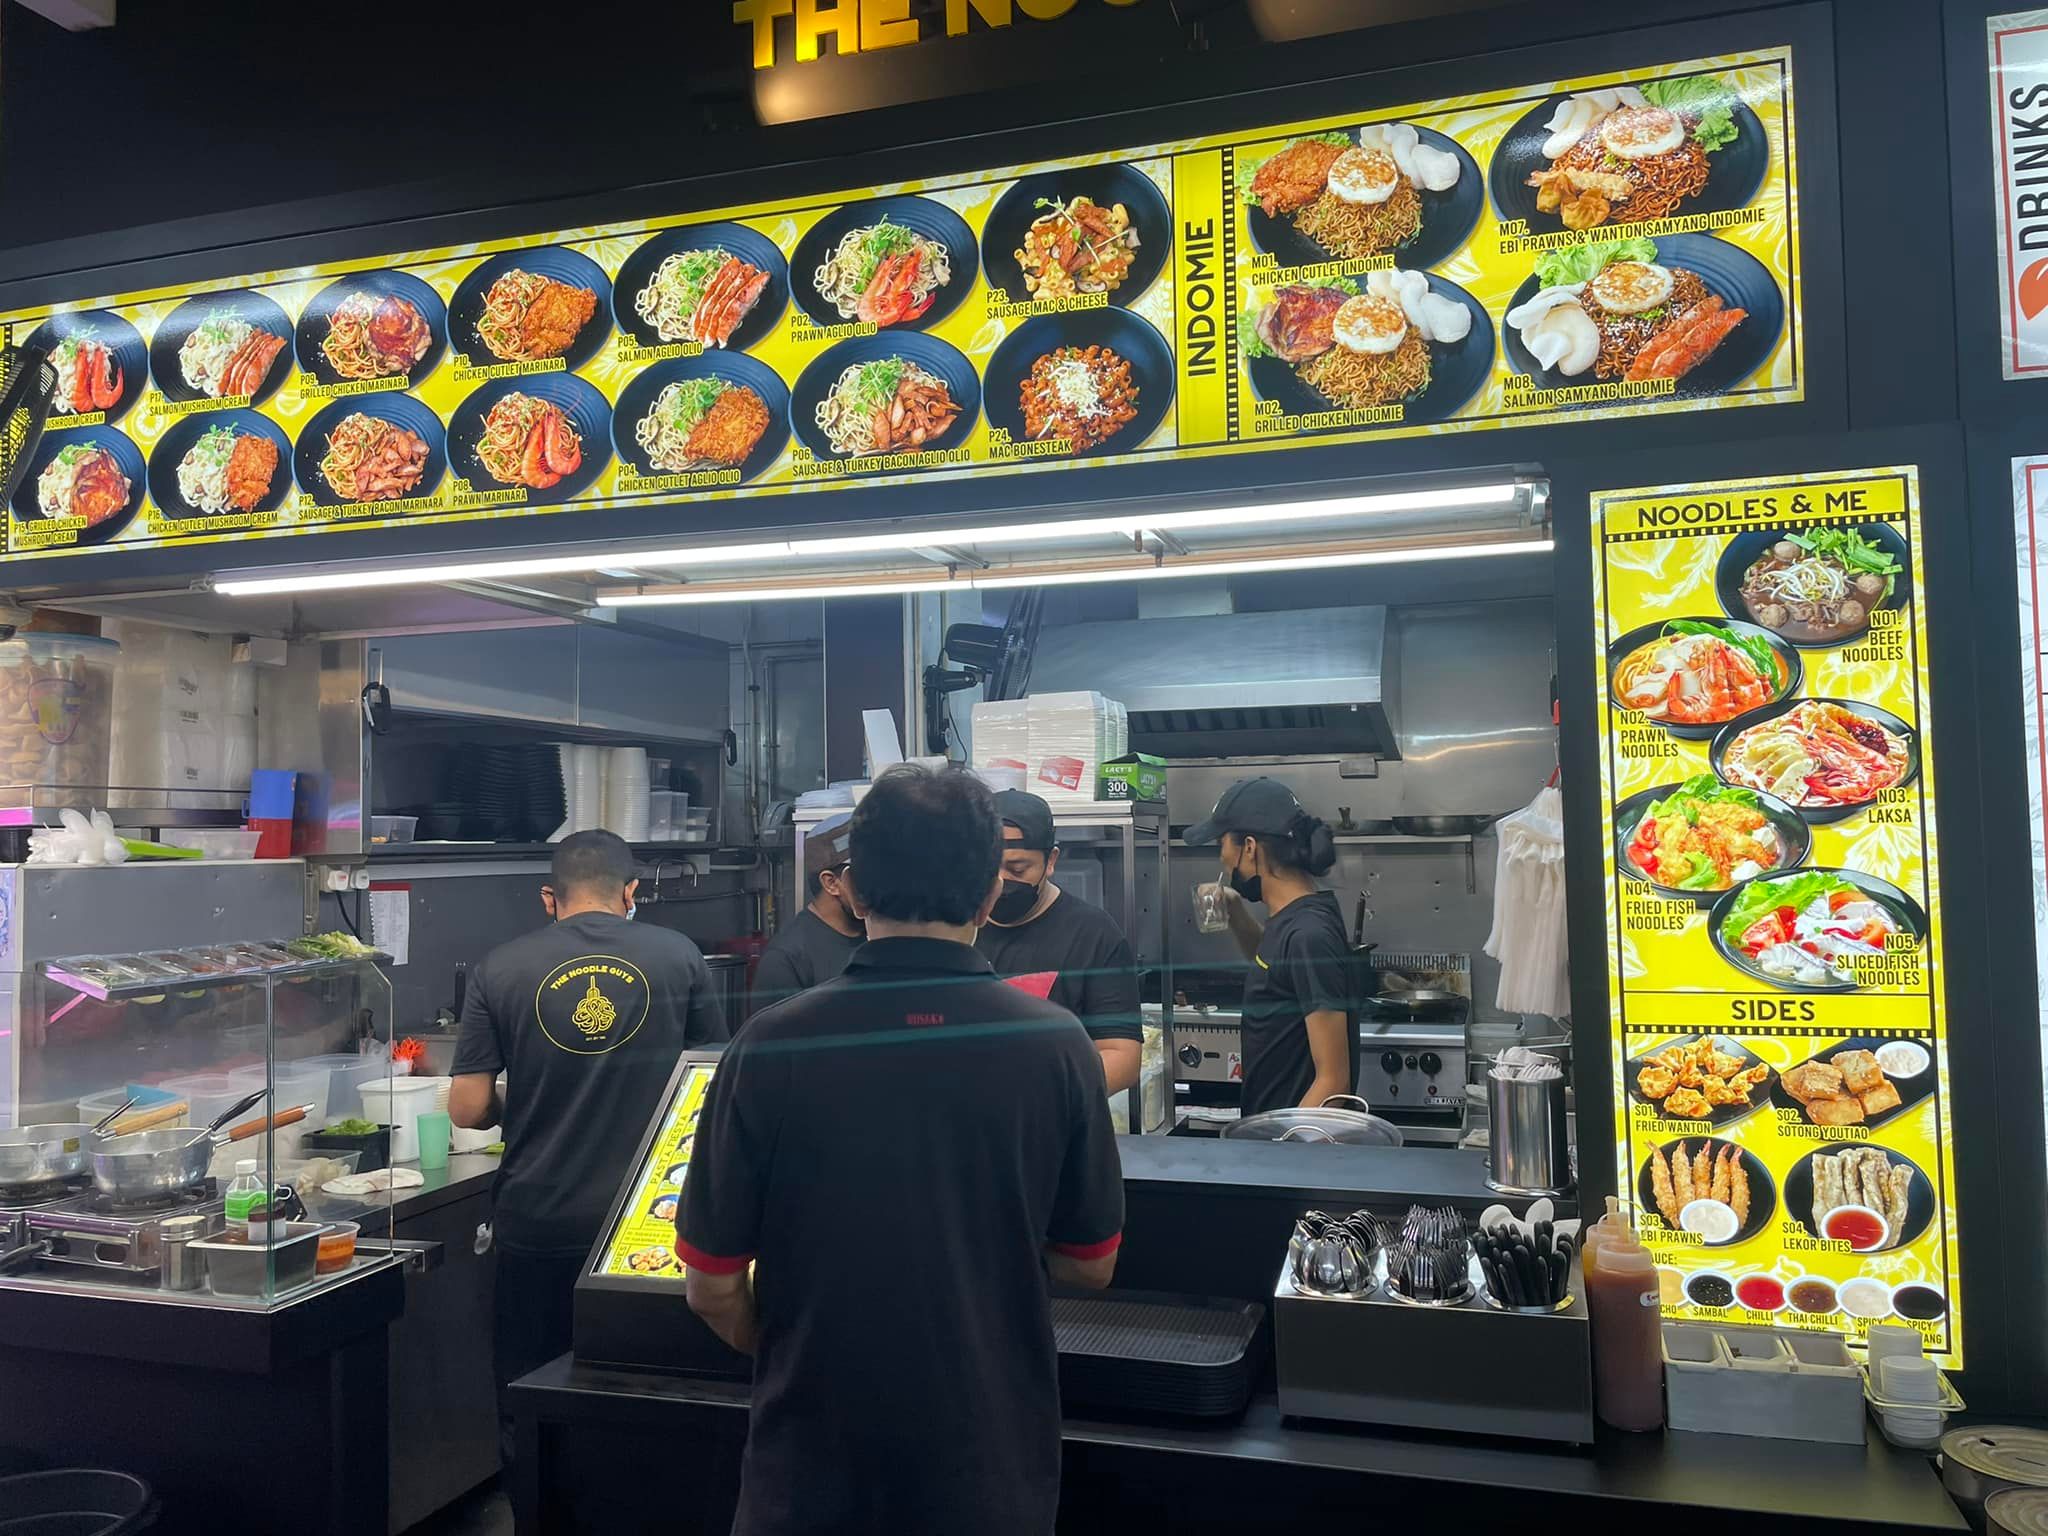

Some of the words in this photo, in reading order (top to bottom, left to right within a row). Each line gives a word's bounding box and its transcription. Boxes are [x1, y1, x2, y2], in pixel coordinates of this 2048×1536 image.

[733, 0, 919, 69] THE
[1500, 240, 1519, 254] EBI
[1523, 234, 1573, 252] PRAWNS
[1577, 232, 1586, 245] &
[1590, 226, 1642, 243] WANTON
[1646, 217, 1707, 236] SAMYANG
[1710, 210, 1765, 230] INDOMIE
[1251, 271, 1299, 286] CHICKEN
[1302, 265, 1343, 280] CUTLET
[1345, 258, 1394, 275] INDOMIE
[987, 291, 1009, 303] P23.
[1185, 218, 1217, 377] INDOMIE
[987, 304, 1030, 319] SAUSAGE
[1033, 300, 1055, 313] MAC
[1058, 299, 1066, 310] &
[1069, 294, 1107, 309] CHEESE
[791, 329, 823, 343] PRAWN
[826, 325, 853, 338] AGLIO
[855, 322, 876, 334] OLIO
[618, 349, 653, 362] SALMON
[656, 346, 680, 358] AGLIO
[683, 343, 703, 354] OLIO
[454, 369, 488, 381] CHICKEN
[490, 364, 521, 377] CUTLET
[522, 359, 565, 373] MARINARA
[300, 387, 331, 399] GRILLED
[333, 382, 367, 395] CHICKEN
[368, 378, 408, 392] MARINARA
[1504, 392, 1553, 409] SALMON
[1557, 386, 1617, 404] SAMYANG
[1621, 379, 1673, 397] INDOMIE
[149, 405, 178, 416] SALMON
[181, 400, 222, 412] MUSHROOM
[224, 397, 249, 407] CREAM
[46, 416, 79, 429] USHROOM
[80, 413, 104, 425] CREAM
[1255, 418, 1299, 433] GRILLED
[1302, 413, 1351, 429] CHICKEN
[1354, 407, 1403, 423] INDOMIE
[989, 431, 1011, 442] P24.
[989, 446, 1011, 458] MAC
[1013, 440, 1072, 456] BONESTEAK
[792, 462, 833, 476] SAUSAGE
[836, 461, 843, 472] &
[847, 458, 882, 472] TURKEY
[884, 455, 916, 468] BACON
[918, 452, 946, 465] AGLIO
[949, 449, 970, 461] OLIO
[618, 479, 655, 492] CHICKEN
[658, 476, 689, 488] CUTLET
[692, 473, 717, 485] AGLIO
[720, 471, 740, 482] OLIO
[453, 492, 483, 505] PRAWN
[484, 490, 527, 502] MARINARA
[298, 507, 332, 520] SAUSAGE
[343, 504, 372, 516] TURKEY
[375, 501, 400, 513] BACON
[402, 497, 444, 510] MARINARA
[1638, 498, 1777, 528] NOODLES
[1791, 494, 1813, 514] &
[1825, 490, 1867, 512] ME
[30, 520, 55, 530] GRILLED
[57, 518, 86, 528] CHICKEN
[147, 523, 178, 534] CHICKEN
[180, 520, 206, 531] CUTLET
[208, 516, 249, 528] MUSHROOM
[252, 513, 278, 524] CREAM
[14, 534, 52, 546] MUSHROOM
[53, 532, 76, 542] CREAM
[1870, 630, 1902, 645] BEEF
[1842, 647, 1904, 663] NOODLES
[1621, 729, 1665, 744] PRAWN
[1621, 743, 1679, 758] NOODLES
[1107, 782, 1128, 792] 300
[1869, 809, 1912, 824] LAKSA
[1626, 900, 1662, 915] FRIED
[1667, 900, 1695, 915] FISH
[1627, 916, 1684, 931] NOODLES
[1837, 954, 1885, 969] SLICED
[1889, 955, 1919, 969] FISH
[550, 974, 569, 990] THE
[568, 965, 608, 978] NOODLE
[609, 968, 635, 984] GUYS
[1858, 970, 1920, 986] NOODLES
[1731, 999, 1815, 1022] SIDES
[1636, 1120, 1664, 1133] FRIED
[1667, 1121, 1711, 1135] WANTON
[1777, 1125, 1820, 1139] SOTONG
[1822, 1126, 1868, 1140] YOUTIAO
[650, 1151, 673, 1184] PASTA
[1660, 1231, 1703, 1244] PRAWNS
[1783, 1238, 1818, 1251] LEKOR
[1821, 1240, 1851, 1253] BITES
[1652, 1252, 1677, 1265] UCE:
[1660, 1304, 1677, 1314] CHO
[1693, 1307, 1728, 1318] SAMBAL
[1746, 1311, 1773, 1321] CHILLI
[1788, 1313, 1808, 1324] THAI
[1810, 1314, 1838, 1325] CHILLI
[1907, 1320, 1932, 1331] SPICY
